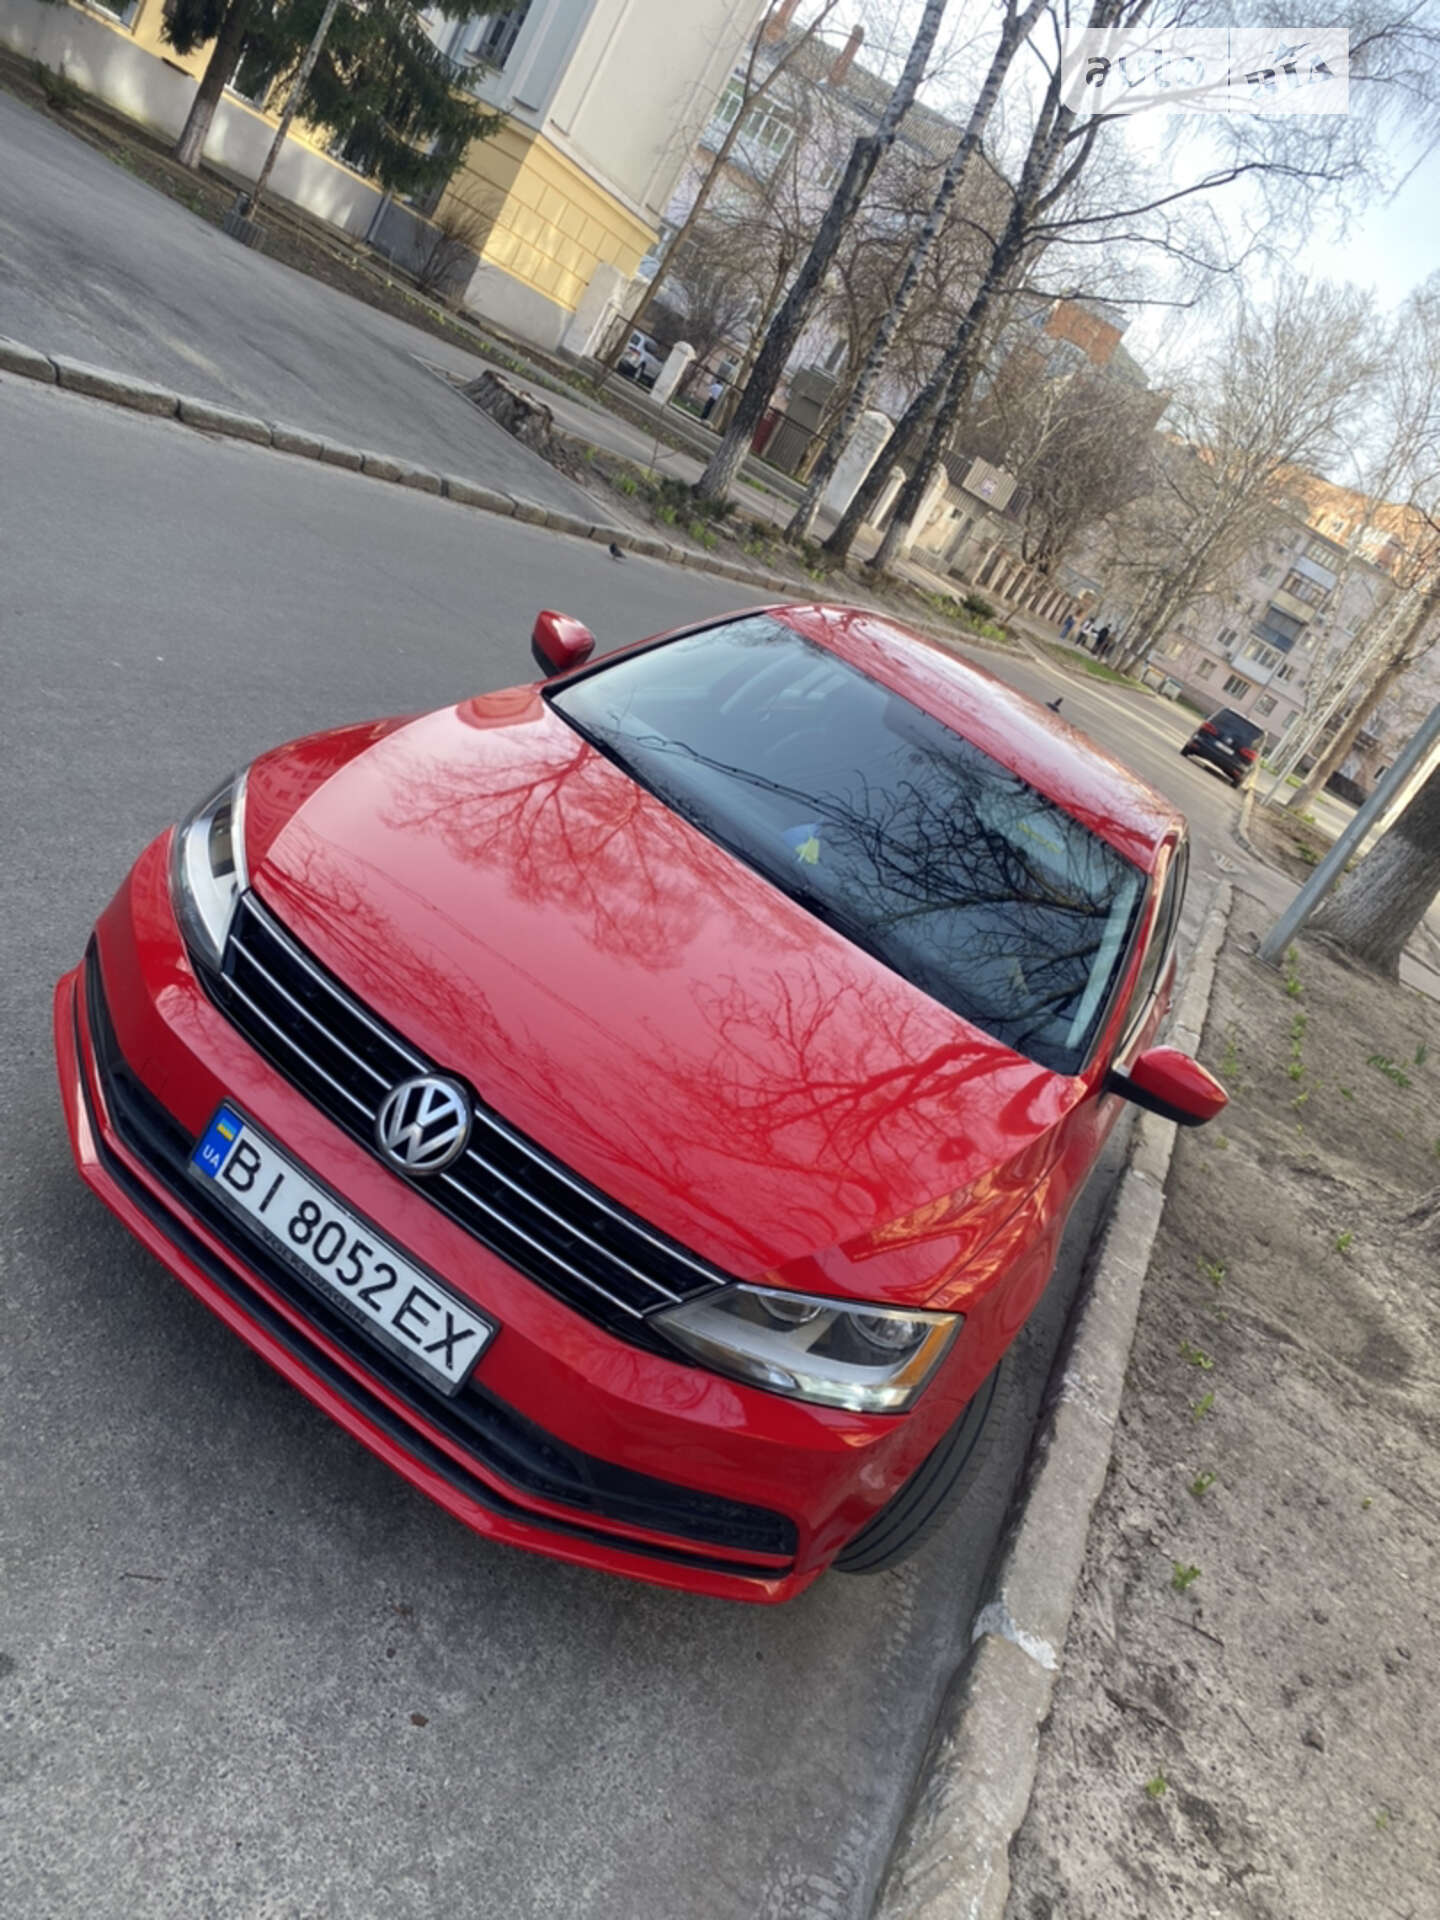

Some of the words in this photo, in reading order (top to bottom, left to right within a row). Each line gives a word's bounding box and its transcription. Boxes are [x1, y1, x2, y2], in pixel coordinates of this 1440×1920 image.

[202, 1145, 221, 1168] UA
[222, 1139, 285, 1213] BI
[288, 1200, 398, 1312] 8052
[392, 1286, 475, 1370] EX
